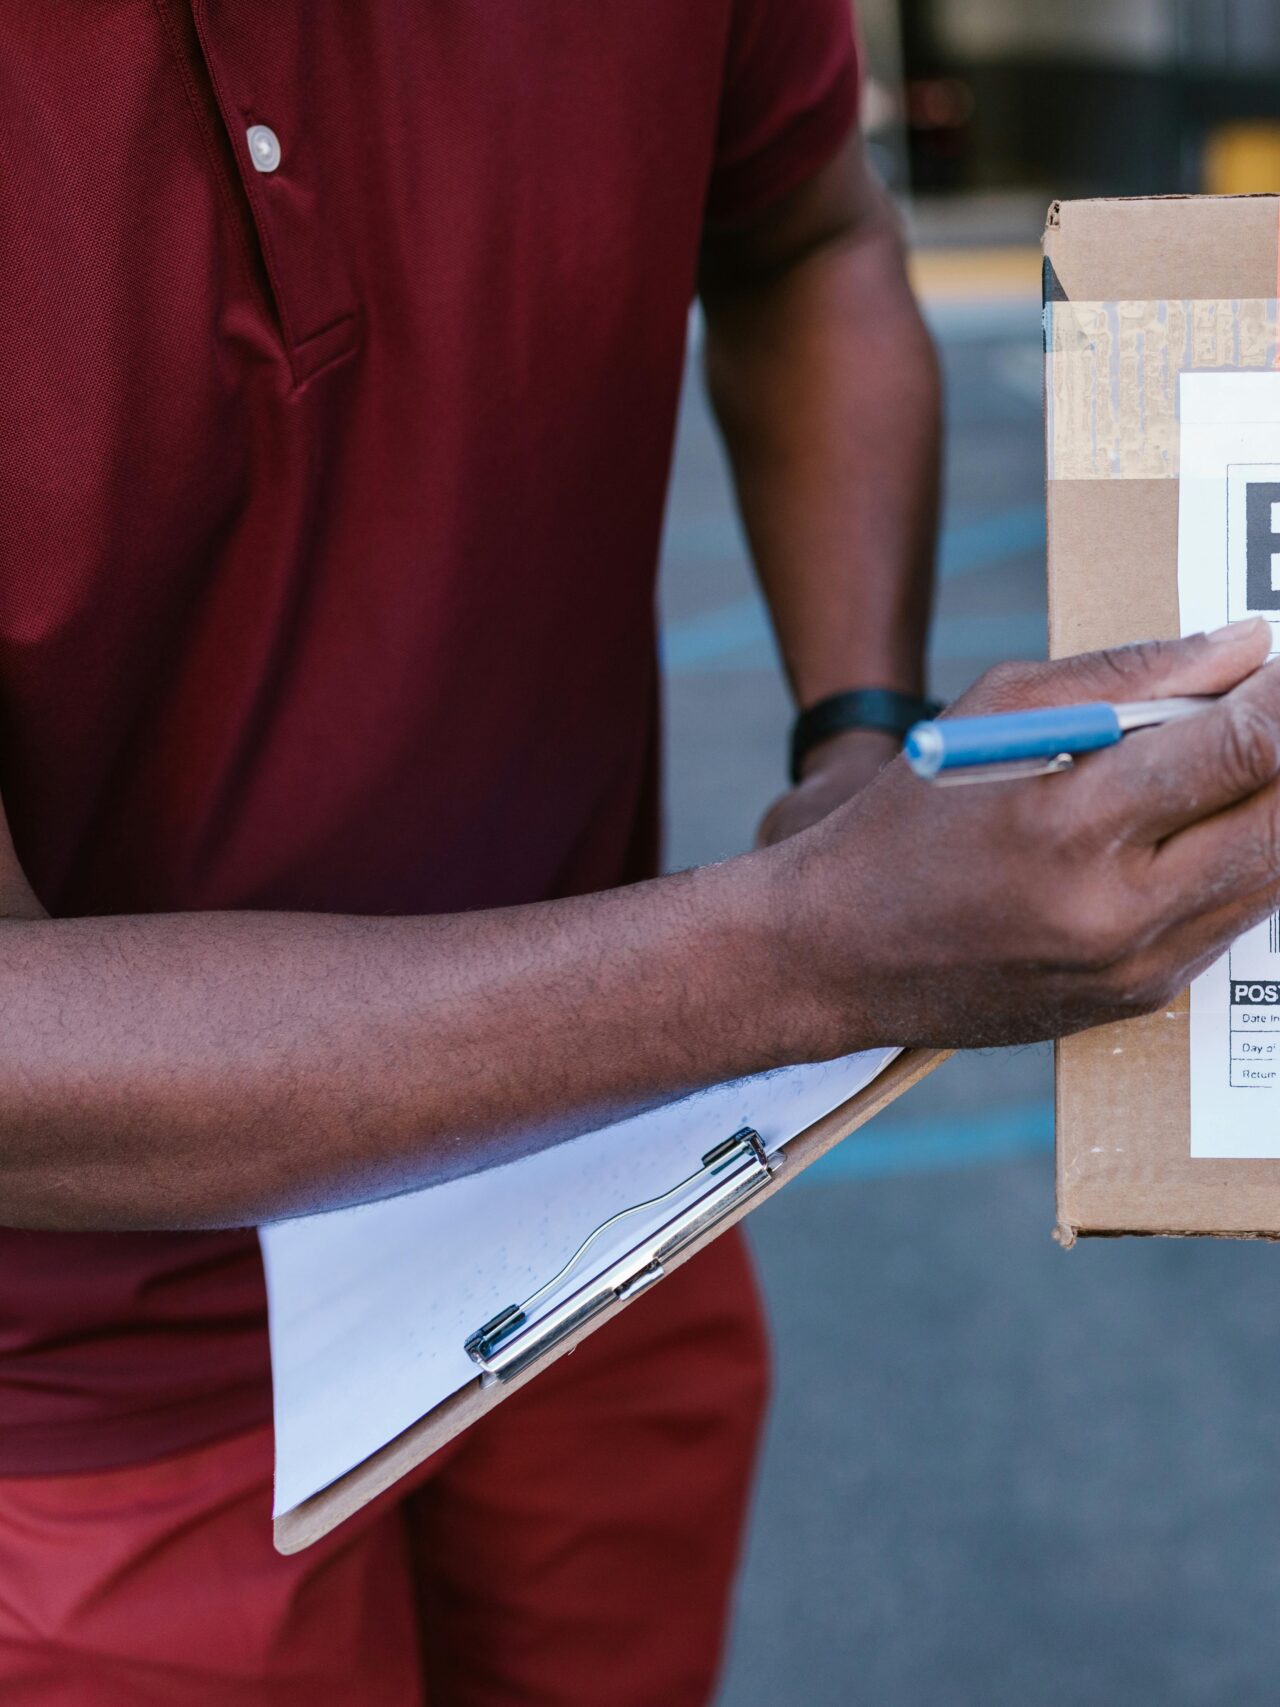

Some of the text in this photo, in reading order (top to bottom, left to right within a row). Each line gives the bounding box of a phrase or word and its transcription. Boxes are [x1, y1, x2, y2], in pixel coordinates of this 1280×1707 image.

[1242, 1014, 1280, 1023] Date In
[1242, 1043, 1263, 1054] Day
[1242, 1070, 1277, 1079] Return
